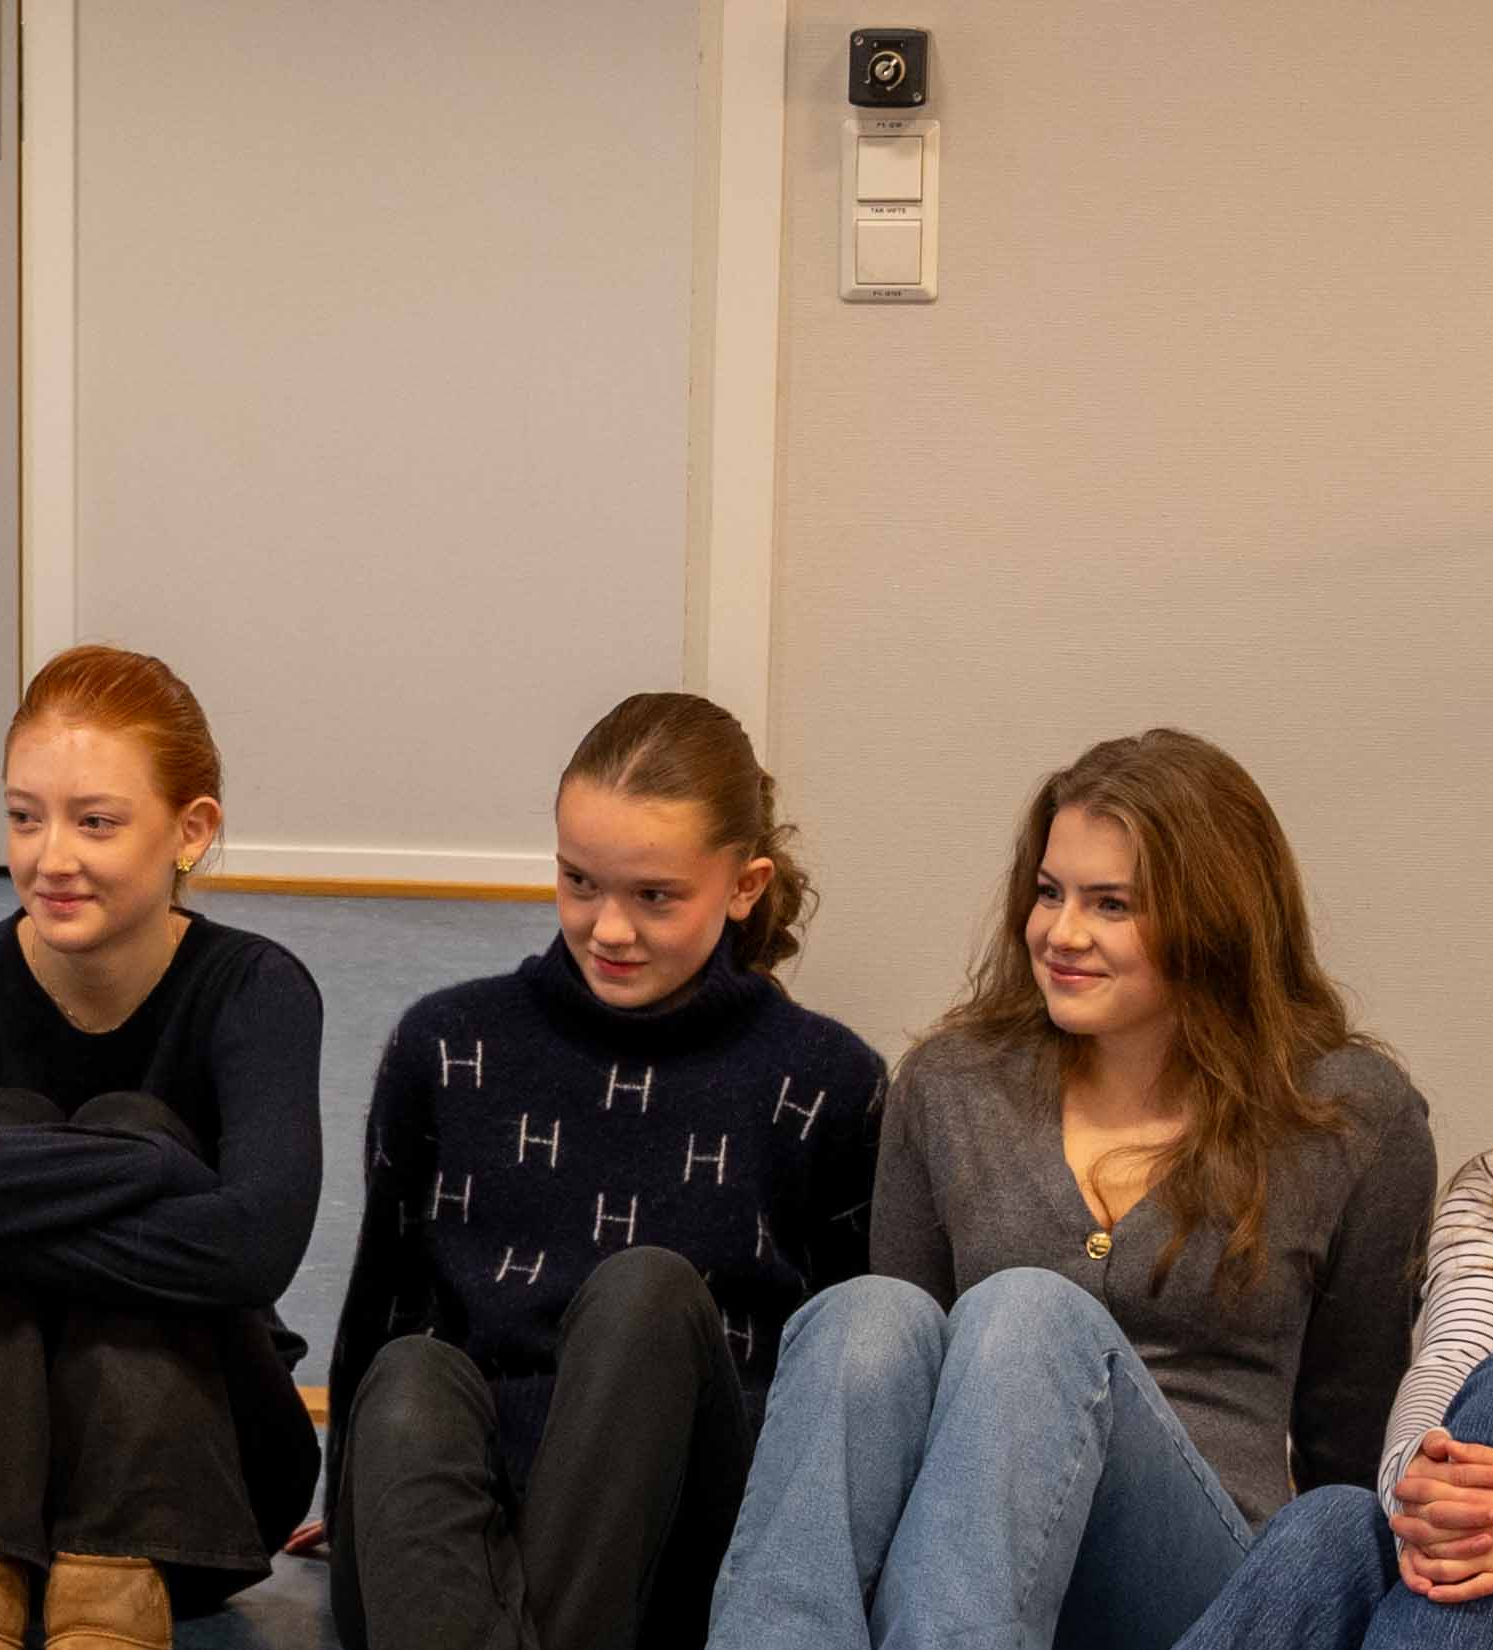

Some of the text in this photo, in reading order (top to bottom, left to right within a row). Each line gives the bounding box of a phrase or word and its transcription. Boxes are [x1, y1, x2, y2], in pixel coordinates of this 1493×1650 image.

[439, 1038, 482, 1088] H
[605, 1064, 652, 1112] H
[772, 1076, 825, 1140] H
[518, 1113, 560, 1168] H
[684, 1133, 727, 1185] H
[430, 1170, 472, 1224] H
[593, 1193, 637, 1245] H
[495, 1246, 545, 1285] H
